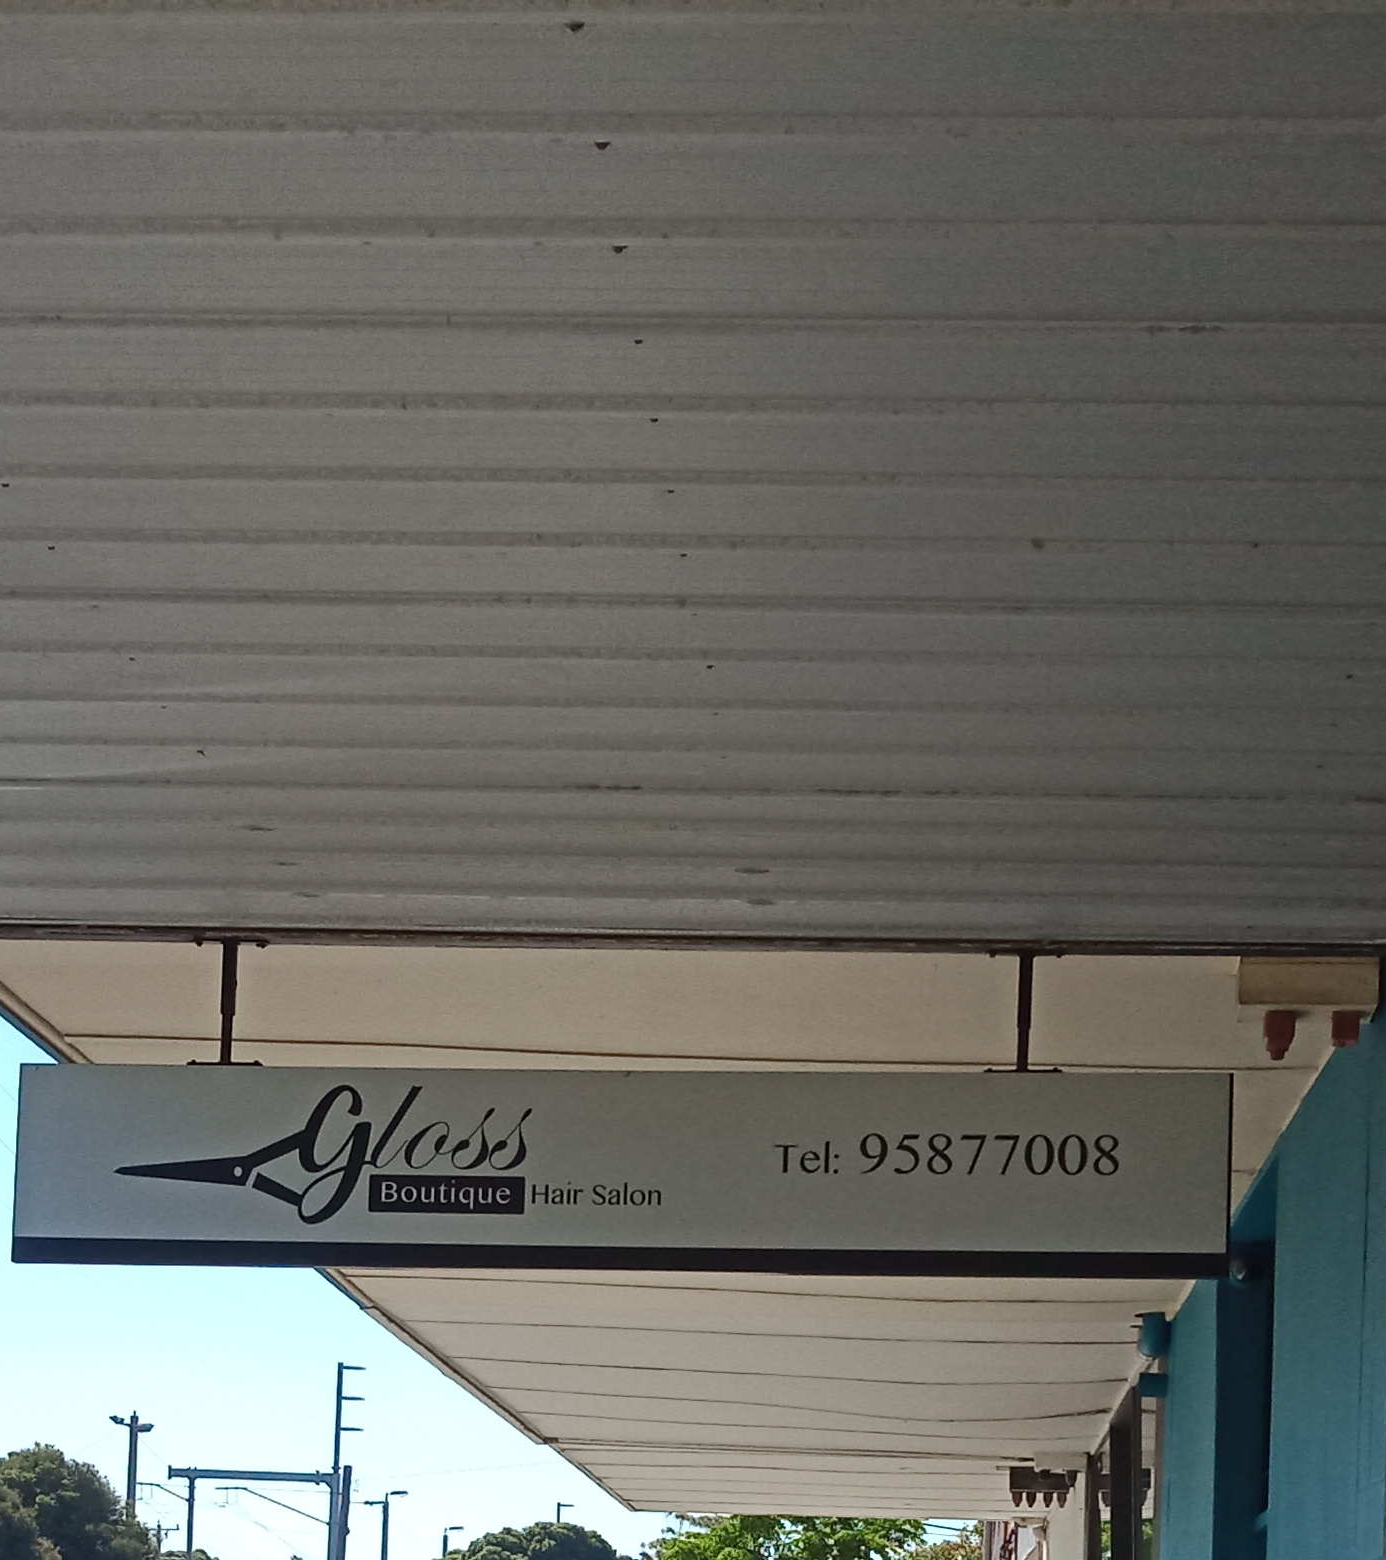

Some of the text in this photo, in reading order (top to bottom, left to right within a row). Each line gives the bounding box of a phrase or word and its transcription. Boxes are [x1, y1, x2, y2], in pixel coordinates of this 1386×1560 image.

[773, 1133, 1120, 1176] Tel: 95877008
[380, 1179, 662, 1209] Boutique Hair Salon
